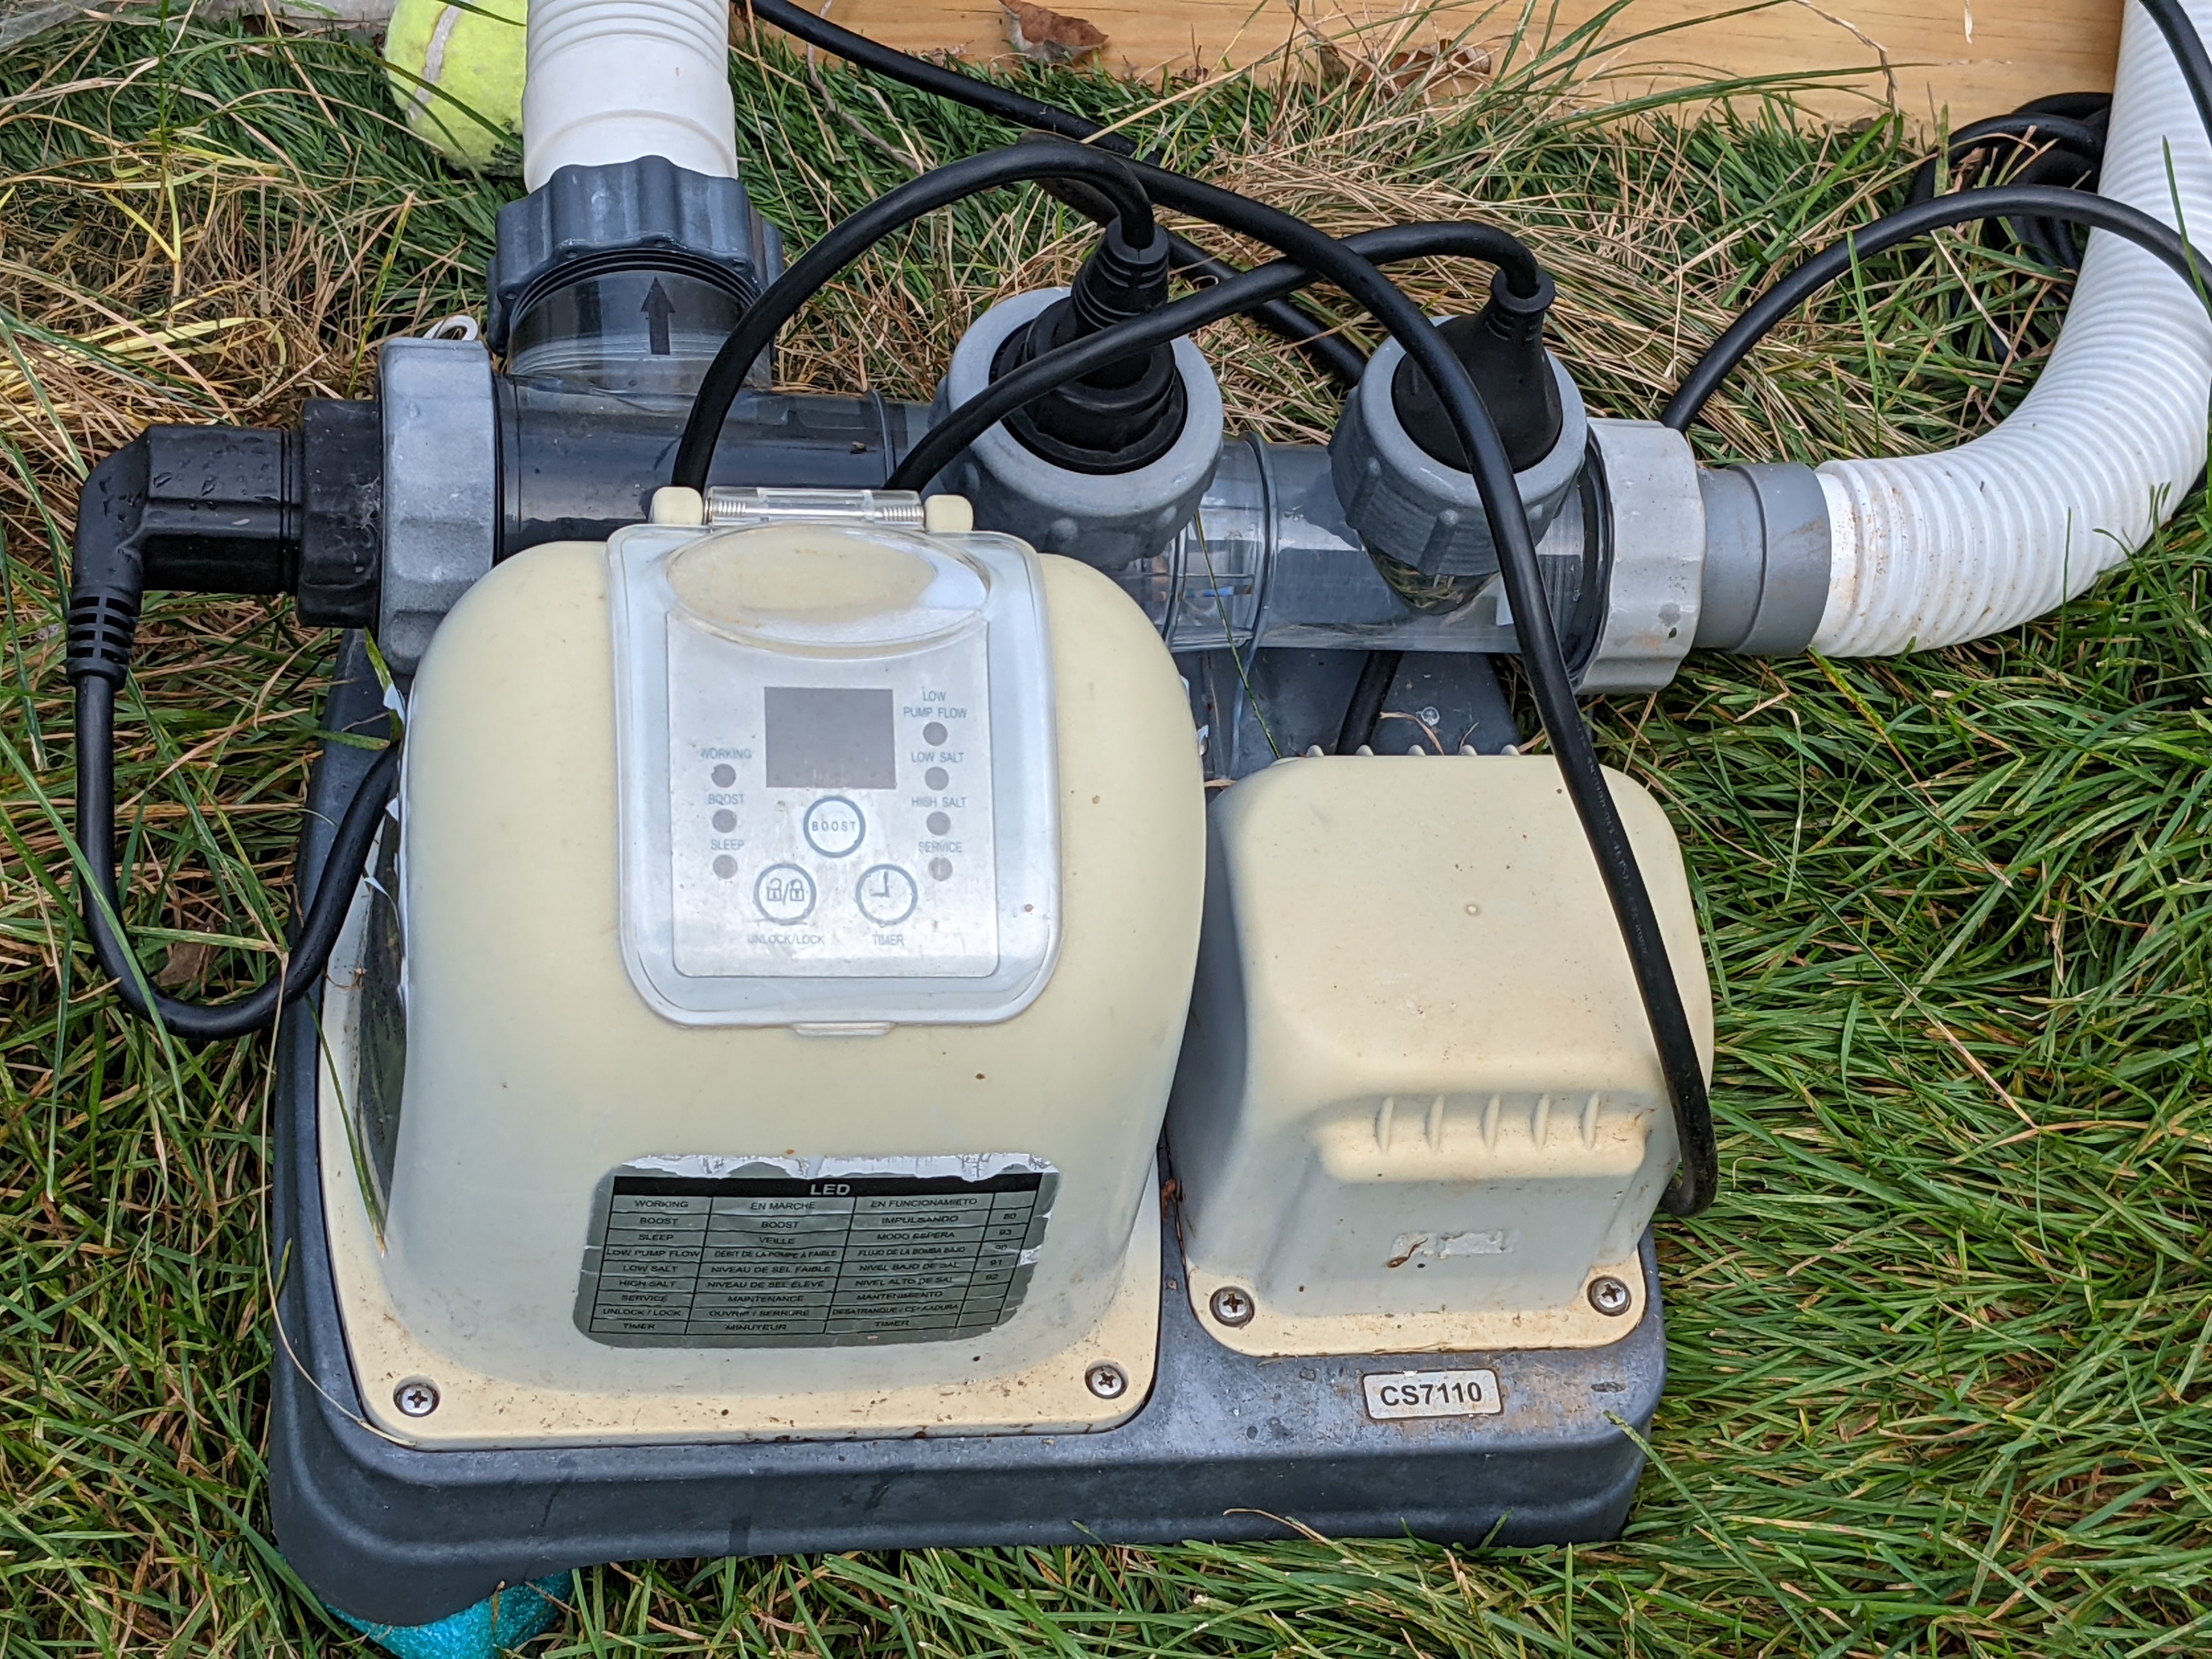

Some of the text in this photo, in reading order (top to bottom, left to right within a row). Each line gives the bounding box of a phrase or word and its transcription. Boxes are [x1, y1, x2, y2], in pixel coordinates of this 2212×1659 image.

[922, 690, 946, 702] LOW
[903, 706, 967, 719] PUMP FLOW
[701, 747, 752, 759] WORKING
[911, 752, 964, 762] LOW SALT
[708, 793, 744, 805] BOOST
[911, 797, 967, 808] HIGH SALT
[812, 821, 857, 831] BOOST
[710, 839, 744, 850] SLEEP
[918, 841, 963, 853] SERVICE
[747, 934, 825, 945] UNLOCK/LOCK
[872, 934, 904, 946] TIMER
[810, 1184, 851, 1195] LED
[635, 1200, 688, 1208] WORKING
[769, 1202, 816, 1210] MARCHE
[881, 1215, 959, 1224] IMPULSANDO
[795, 1266, 832, 1274] FAIBLE
[1380, 1382, 1483, 1406] CS7110
